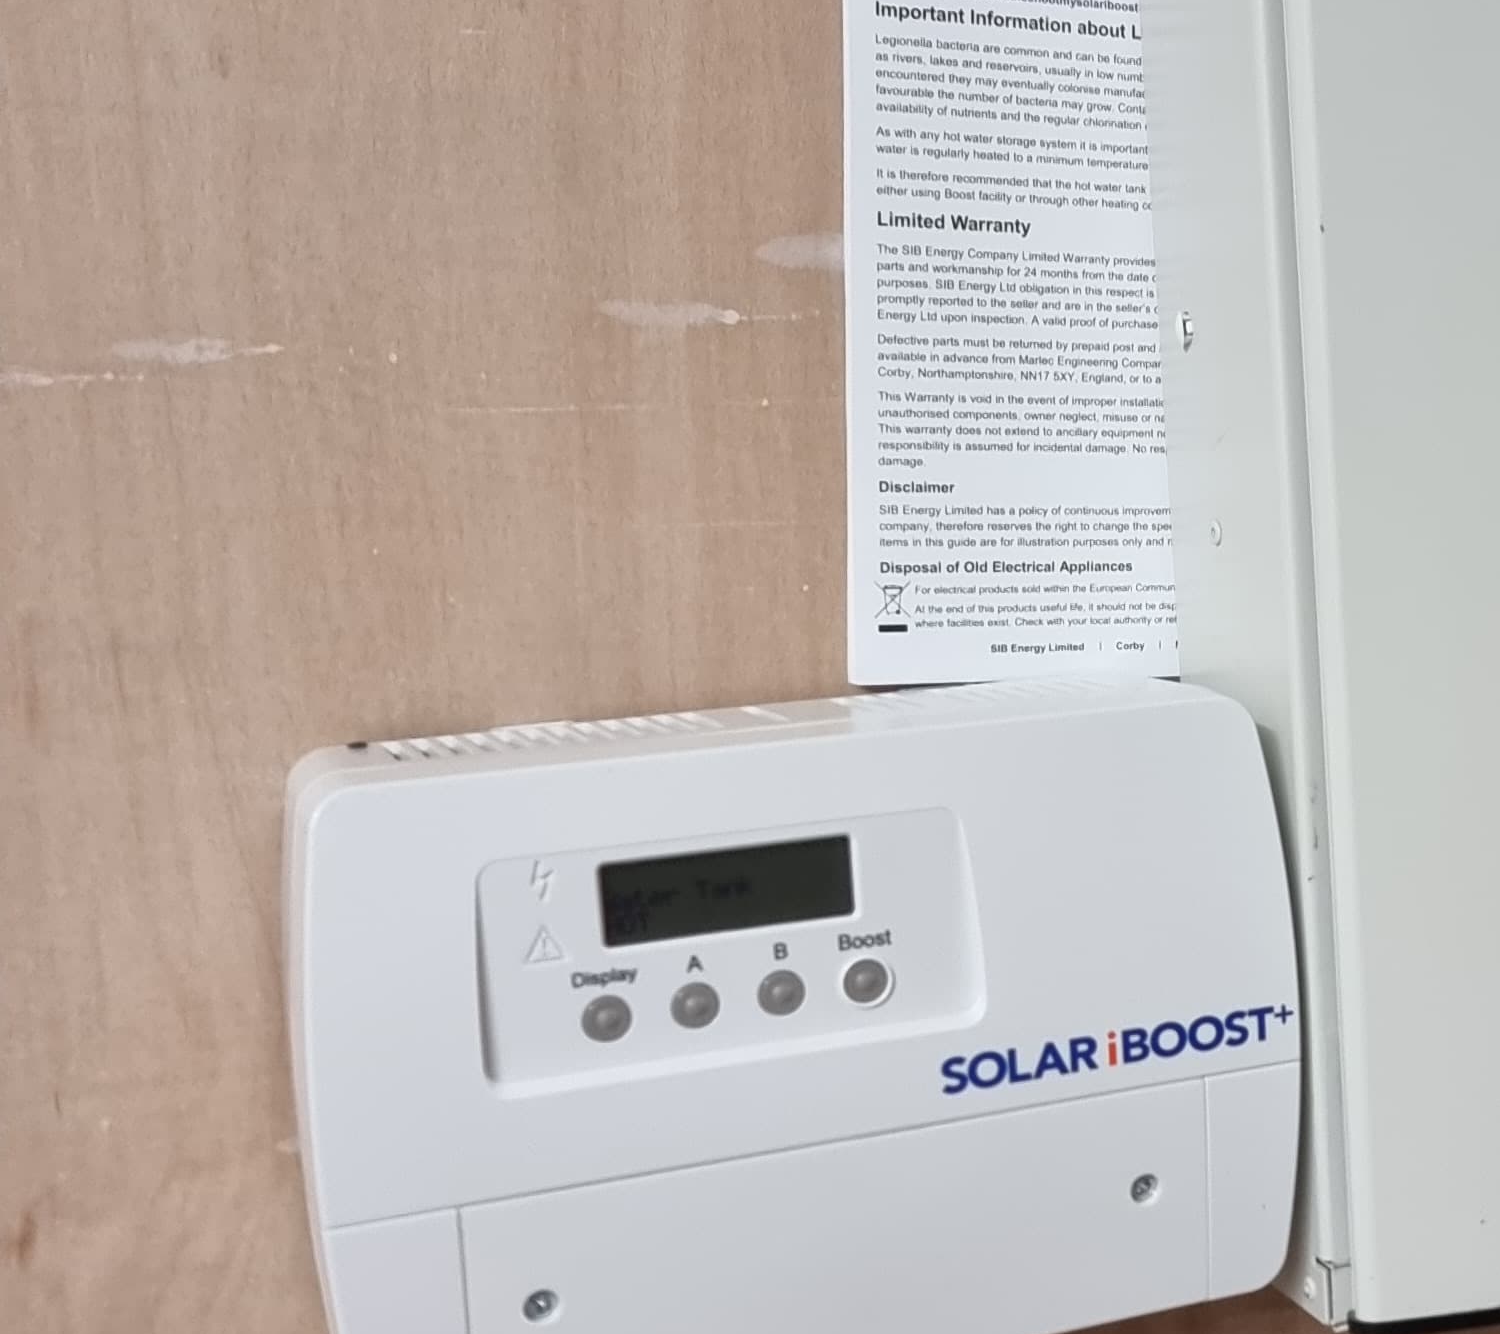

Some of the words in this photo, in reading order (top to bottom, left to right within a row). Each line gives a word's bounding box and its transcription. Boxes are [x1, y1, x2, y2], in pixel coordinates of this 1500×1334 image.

[875, 0, 964, 24] Important
[970, 8, 1071, 33] Information
[1077, 19, 1125, 38] about
[875, 33, 932, 48] Legionella
[936, 38, 979, 52] bacteria
[982, 44, 1000, 54] are
[1003, 46, 1049, 58] common
[1052, 50, 1072, 60] and
[1075, 52, 1094, 61] can
[1097, 52, 1110, 63] be
[1113, 53, 1144, 66] found
[877, 210, 944, 229] Limited
[950, 214, 1030, 238] Warranty
[877, 243, 898, 255] The
[901, 244, 921, 255] SIB
[925, 245, 964, 261] Energy
[967, 247, 1018, 263] Company
[1021, 250, 1060, 262] Limited
[1062, 252, 1110, 267] Warranty
[1113, 256, 1158, 267] provides
[878, 480, 954, 493] Disclaimer
[879, 504, 898, 515] SIB
[902, 504, 941, 517] Energy
[944, 504, 983, 515] Limited
[986, 505, 1005, 515] has
[1008, 507, 1015, 515] a
[1018, 505, 1048, 517] policy
[1050, 504, 1061, 515] of
[1063, 506, 1119, 515] continuous
[879, 561, 941, 576] Disposal
[945, 560, 959, 573] of
[963, 560, 987, 573] Old
[992, 560, 1054, 572] Electrical
[1059, 560, 1132, 575] Appliances
[990, 643, 1007, 653] SIB
[1010, 643, 1046, 654] Energy
[1048, 642, 1086, 651] Limited
[1115, 641, 1144, 651] Corby
[571, 967, 638, 989] Display
[686, 954, 704, 973] A
[773, 941, 788, 959] B
[838, 929, 892, 949] Boost
[941, 1036, 1098, 1095] SOLAR
